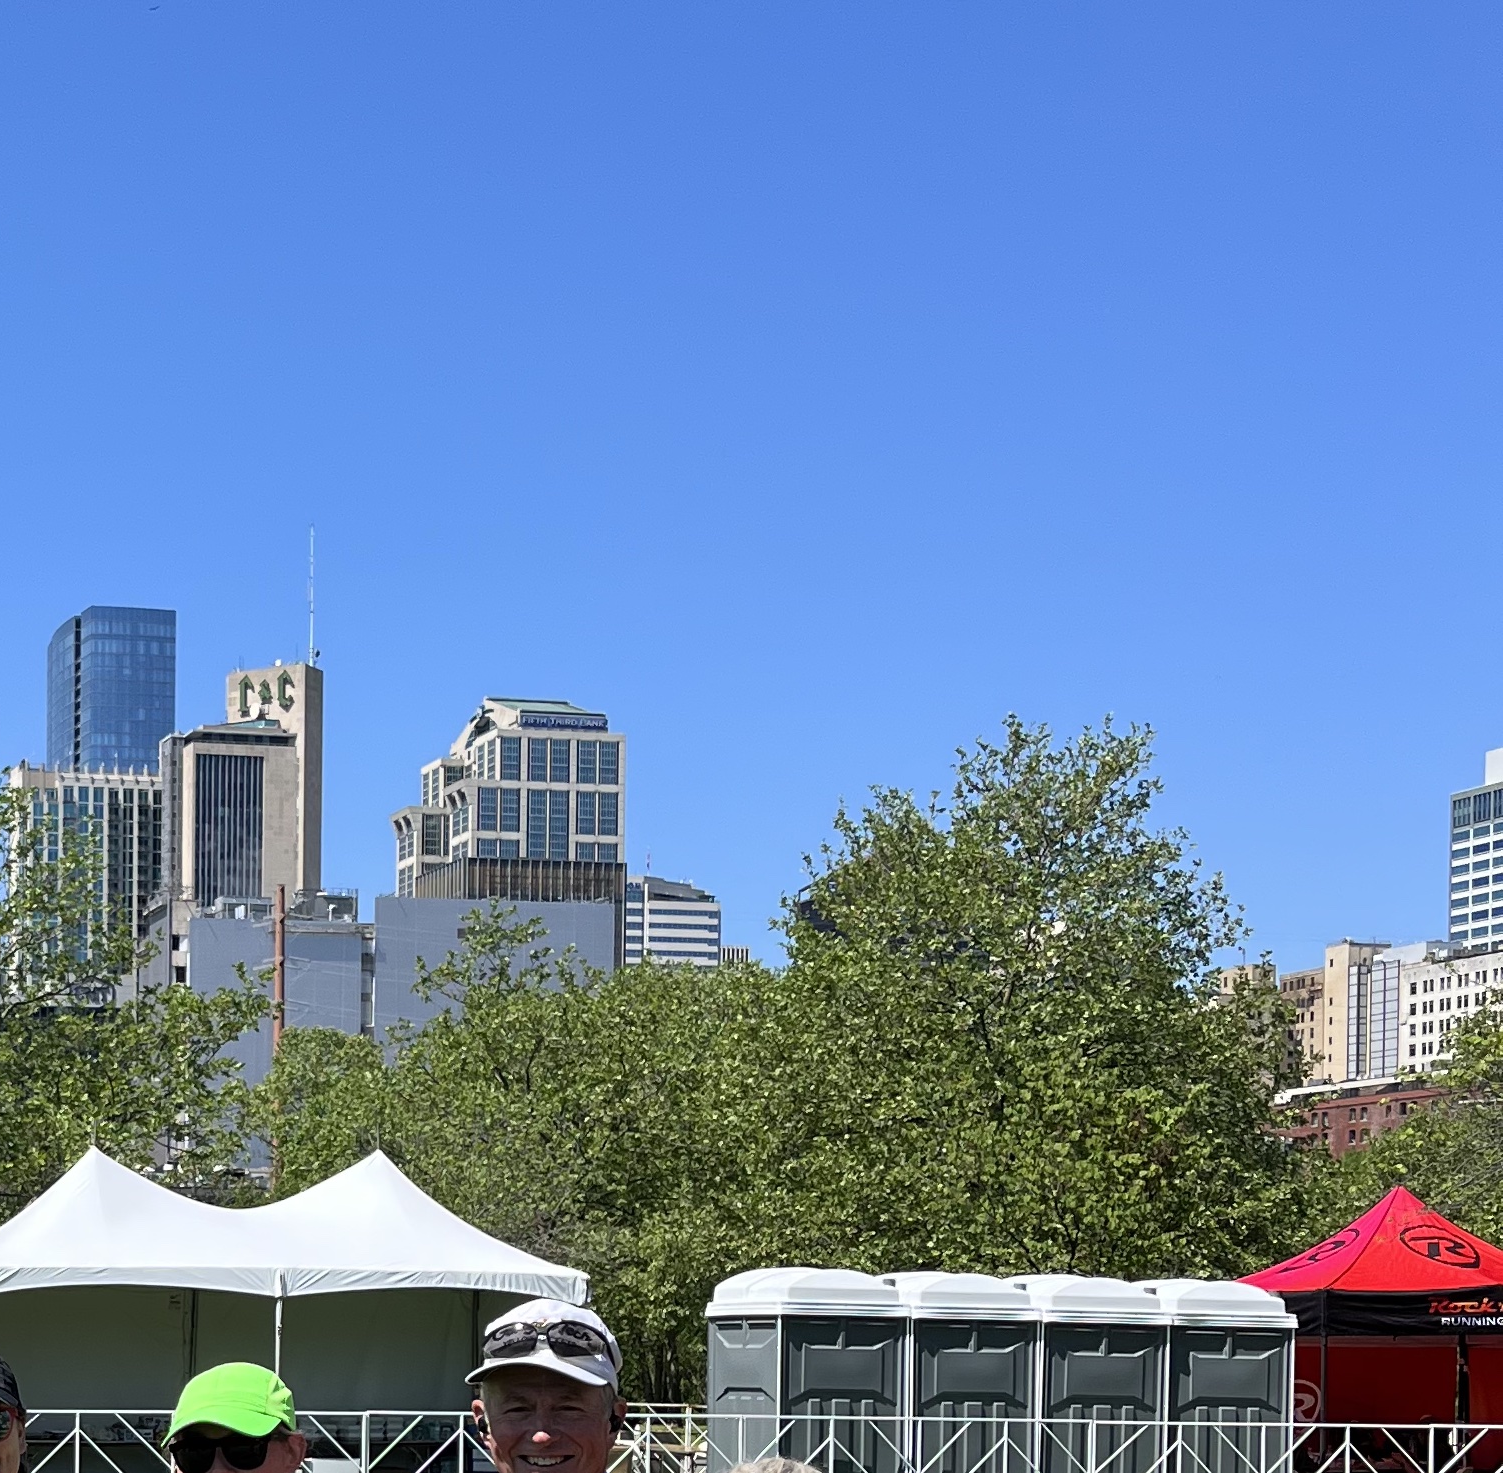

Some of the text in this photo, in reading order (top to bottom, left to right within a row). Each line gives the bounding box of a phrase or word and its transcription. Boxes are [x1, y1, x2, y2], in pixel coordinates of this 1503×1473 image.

[522, 716, 604, 727] FIFTH THIRD BANK
